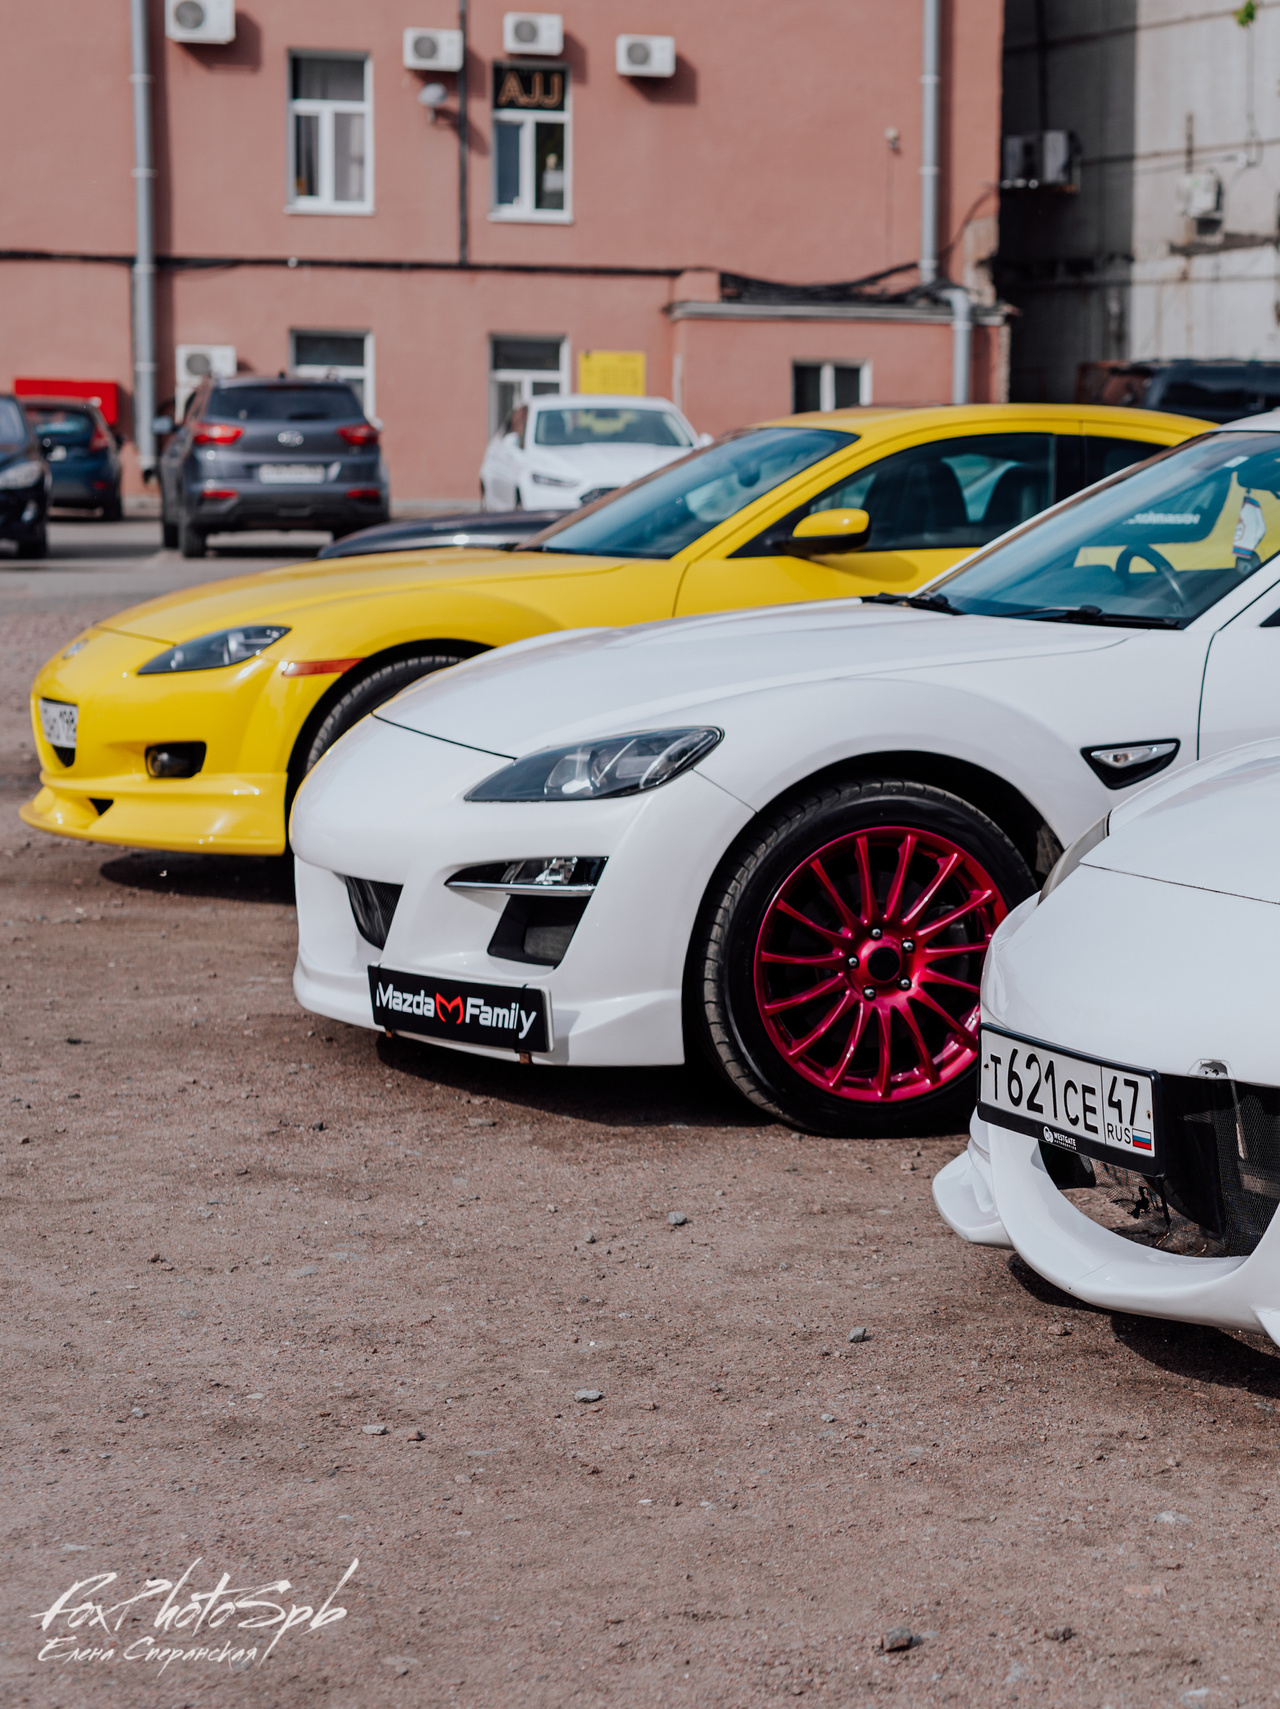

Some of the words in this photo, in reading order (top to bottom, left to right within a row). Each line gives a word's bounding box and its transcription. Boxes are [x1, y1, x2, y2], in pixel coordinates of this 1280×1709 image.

[376, 981, 435, 1018] Mazda
[465, 996, 537, 1039] Family
[1108, 1075, 1139, 1126] 47
[1053, 1131, 1077, 1147] WESTGATE
[1107, 1122, 1131, 1145] RUS
